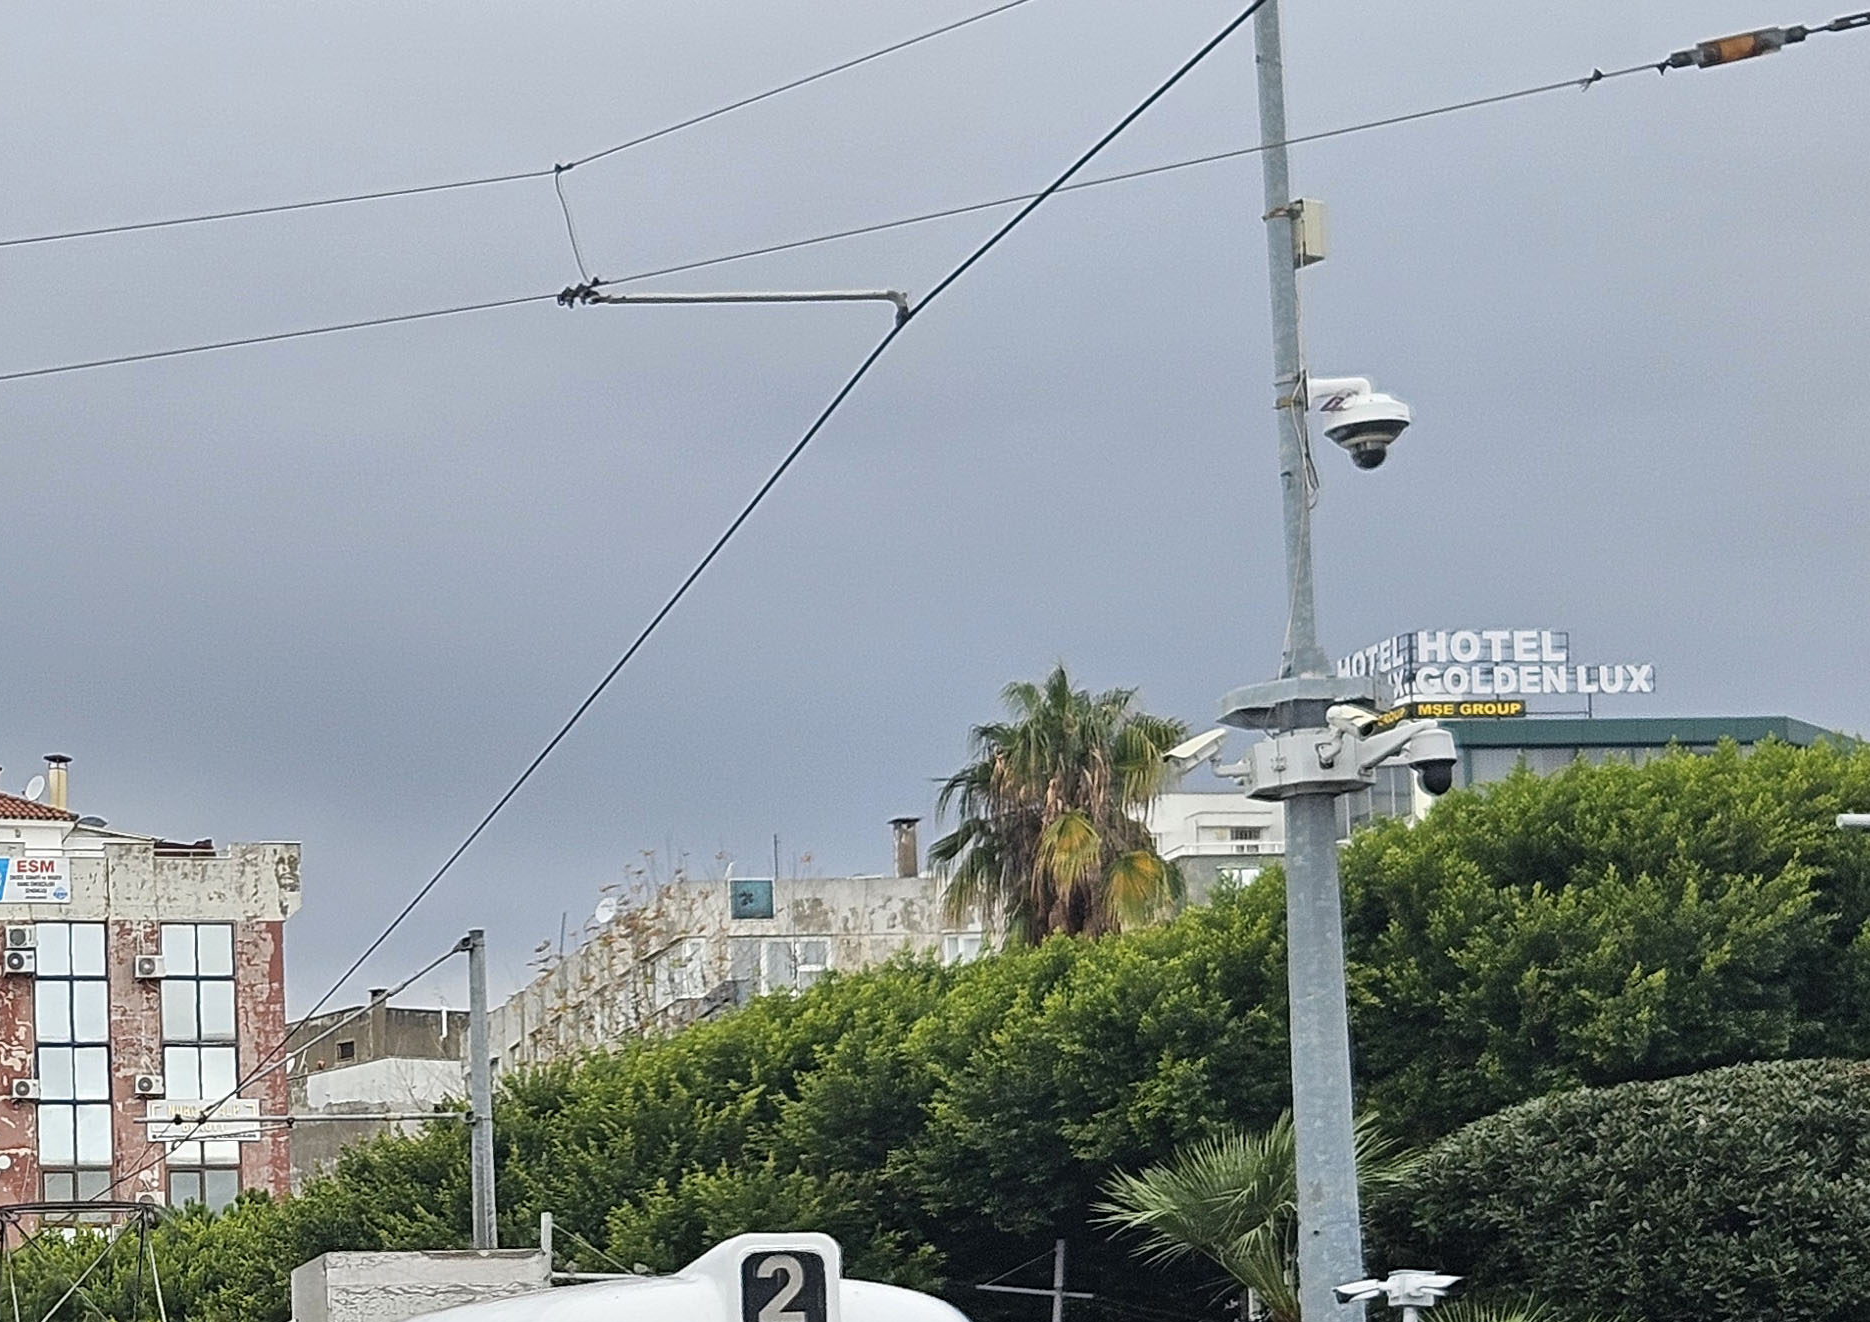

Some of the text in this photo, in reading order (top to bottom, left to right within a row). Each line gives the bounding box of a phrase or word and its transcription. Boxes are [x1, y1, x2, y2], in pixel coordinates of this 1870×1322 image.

[1417, 631, 1568, 662] HOTEL
[1416, 665, 1567, 694] GOLDEN
[1576, 664, 1654, 693] LUX
[1459, 702, 1522, 716] GROUP
[17, 860, 55, 873] ESM
